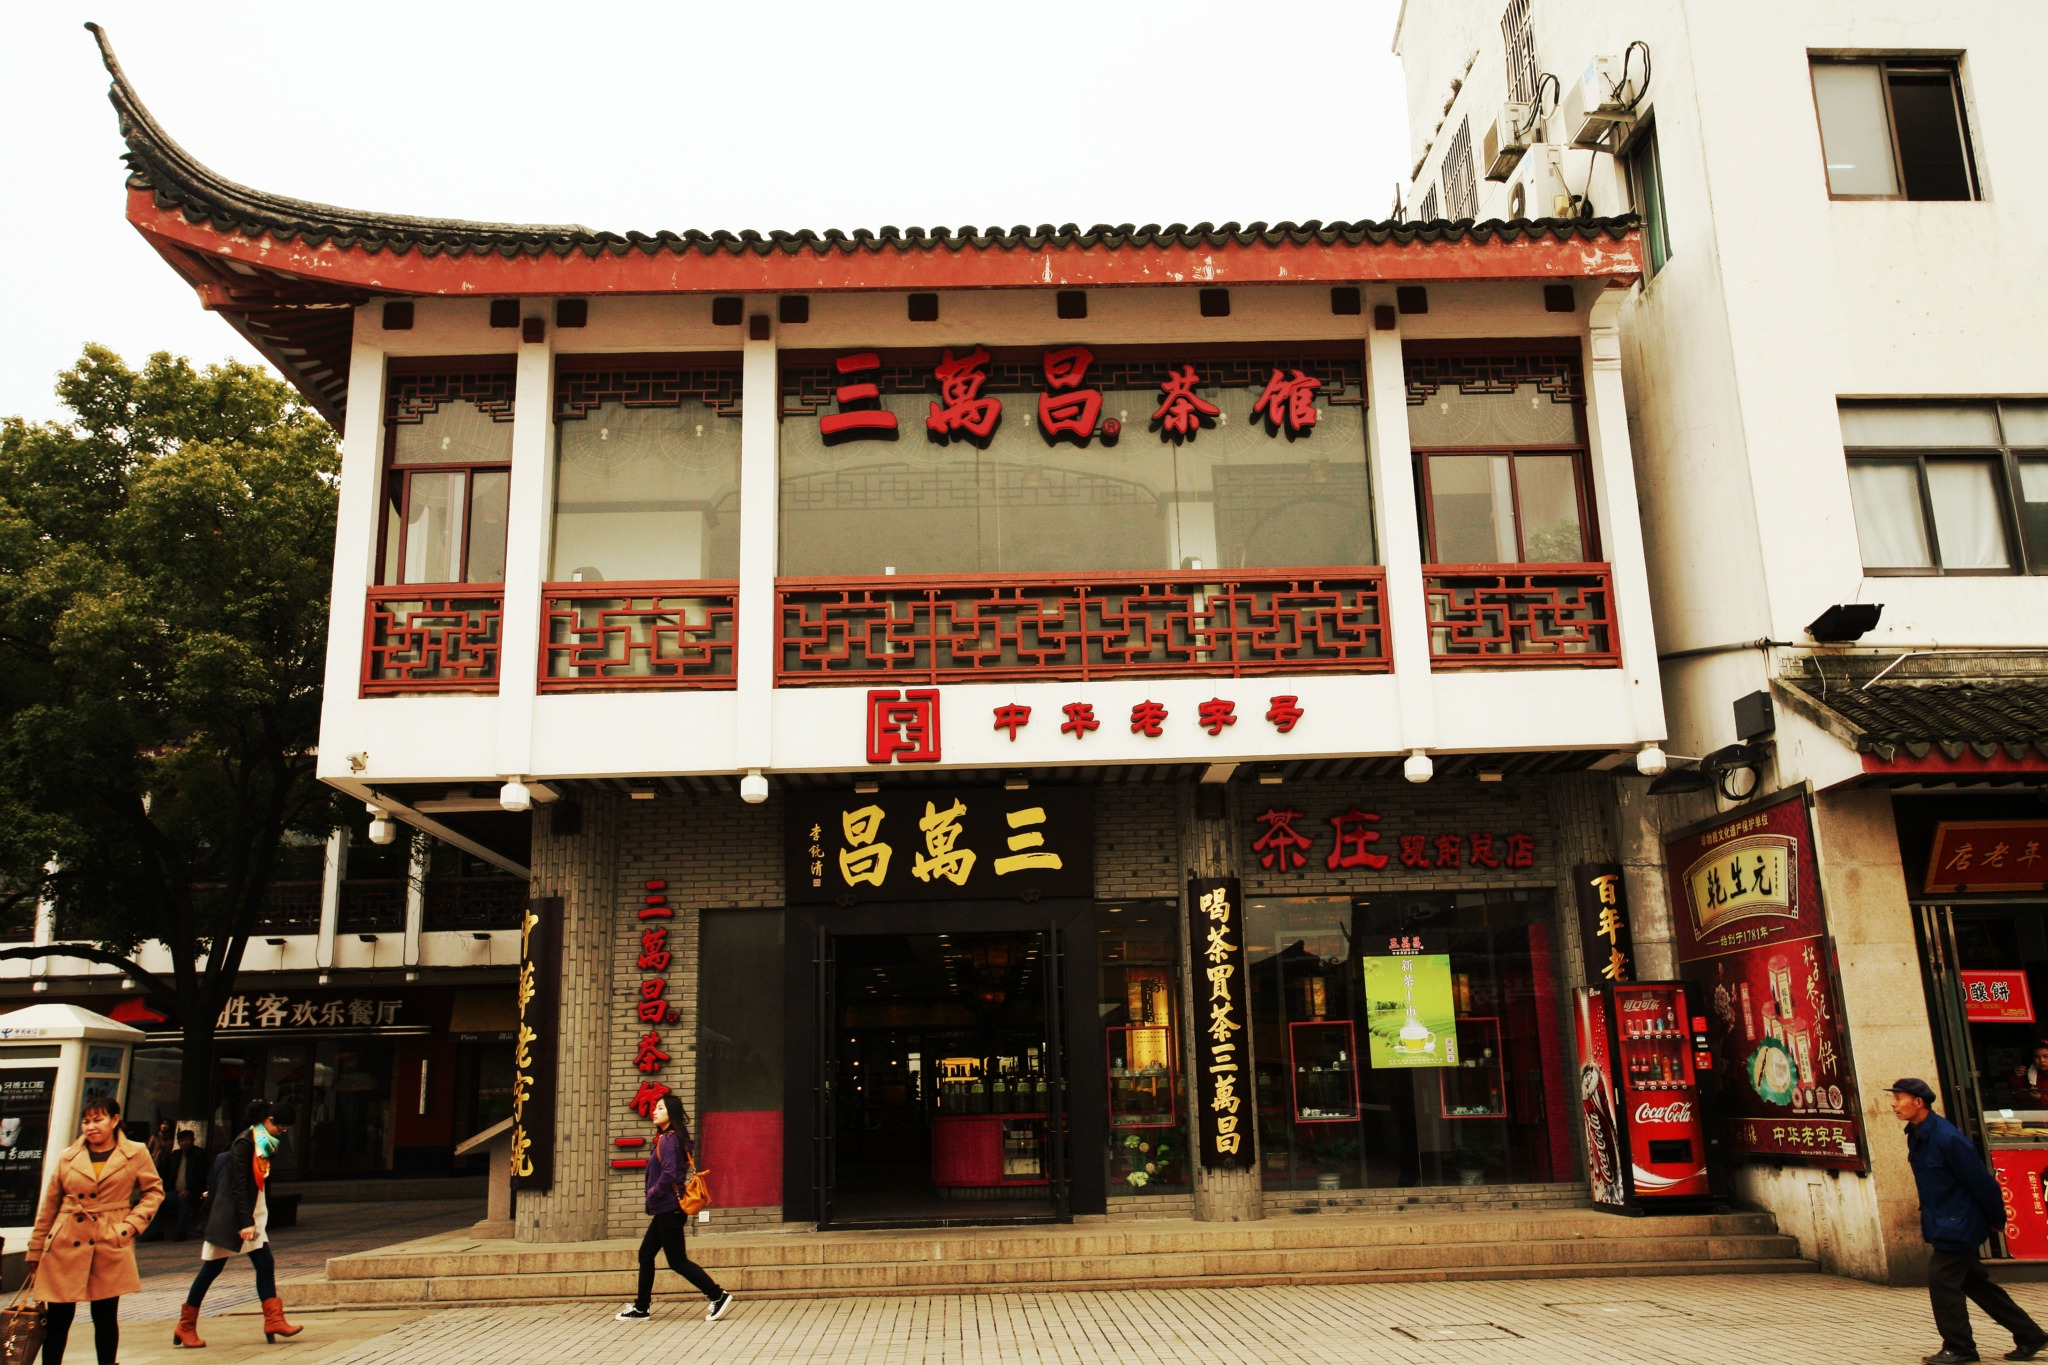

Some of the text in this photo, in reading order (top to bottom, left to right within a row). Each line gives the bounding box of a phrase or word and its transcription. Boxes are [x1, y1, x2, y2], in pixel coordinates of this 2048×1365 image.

[993, 695, 1304, 742] 中华老字号
[838, 798, 1063, 887] 三萬昌
[1252, 807, 1389, 872] 茶庄
[1701, 813, 1768, 846] 非物质文化遗产保护单位
[1401, 960, 1416, 1016] 新茶上市
[510, 908, 540, 1178] 中華老字號
[1200, 887, 1242, 1156] 喝茶買茶三萬昌
[1635, 1101, 1692, 1124] Coca-Cola
